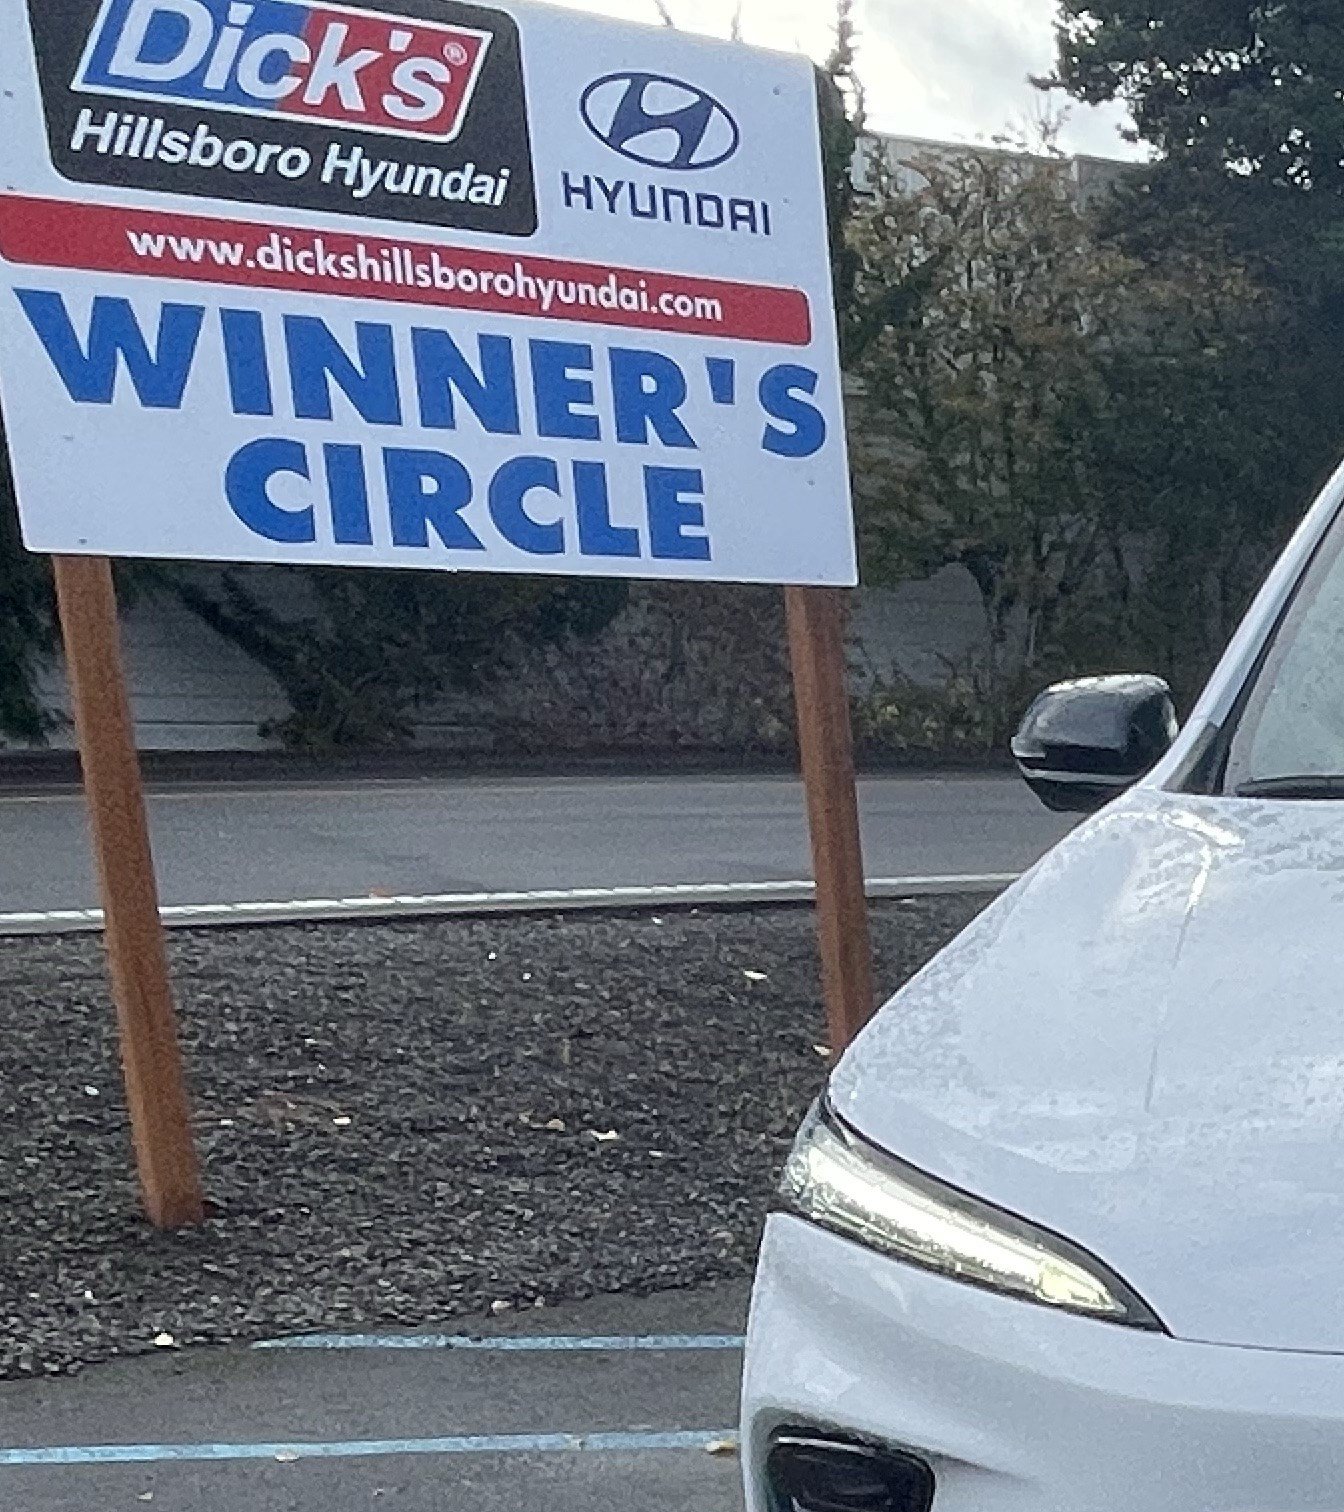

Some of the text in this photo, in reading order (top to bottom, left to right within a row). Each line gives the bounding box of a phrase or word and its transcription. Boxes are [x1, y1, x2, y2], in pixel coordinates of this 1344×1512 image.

[107, 0, 451, 122] Dick's
[70, 108, 510, 206] Hillsboro Hyundai
[562, 172, 770, 236] HYUNDAI
[127, 229, 724, 322] www.dickshillsborohyundai.com
[13, 287, 826, 458] WINNER'S
[224, 437, 711, 562] CIRCLE
